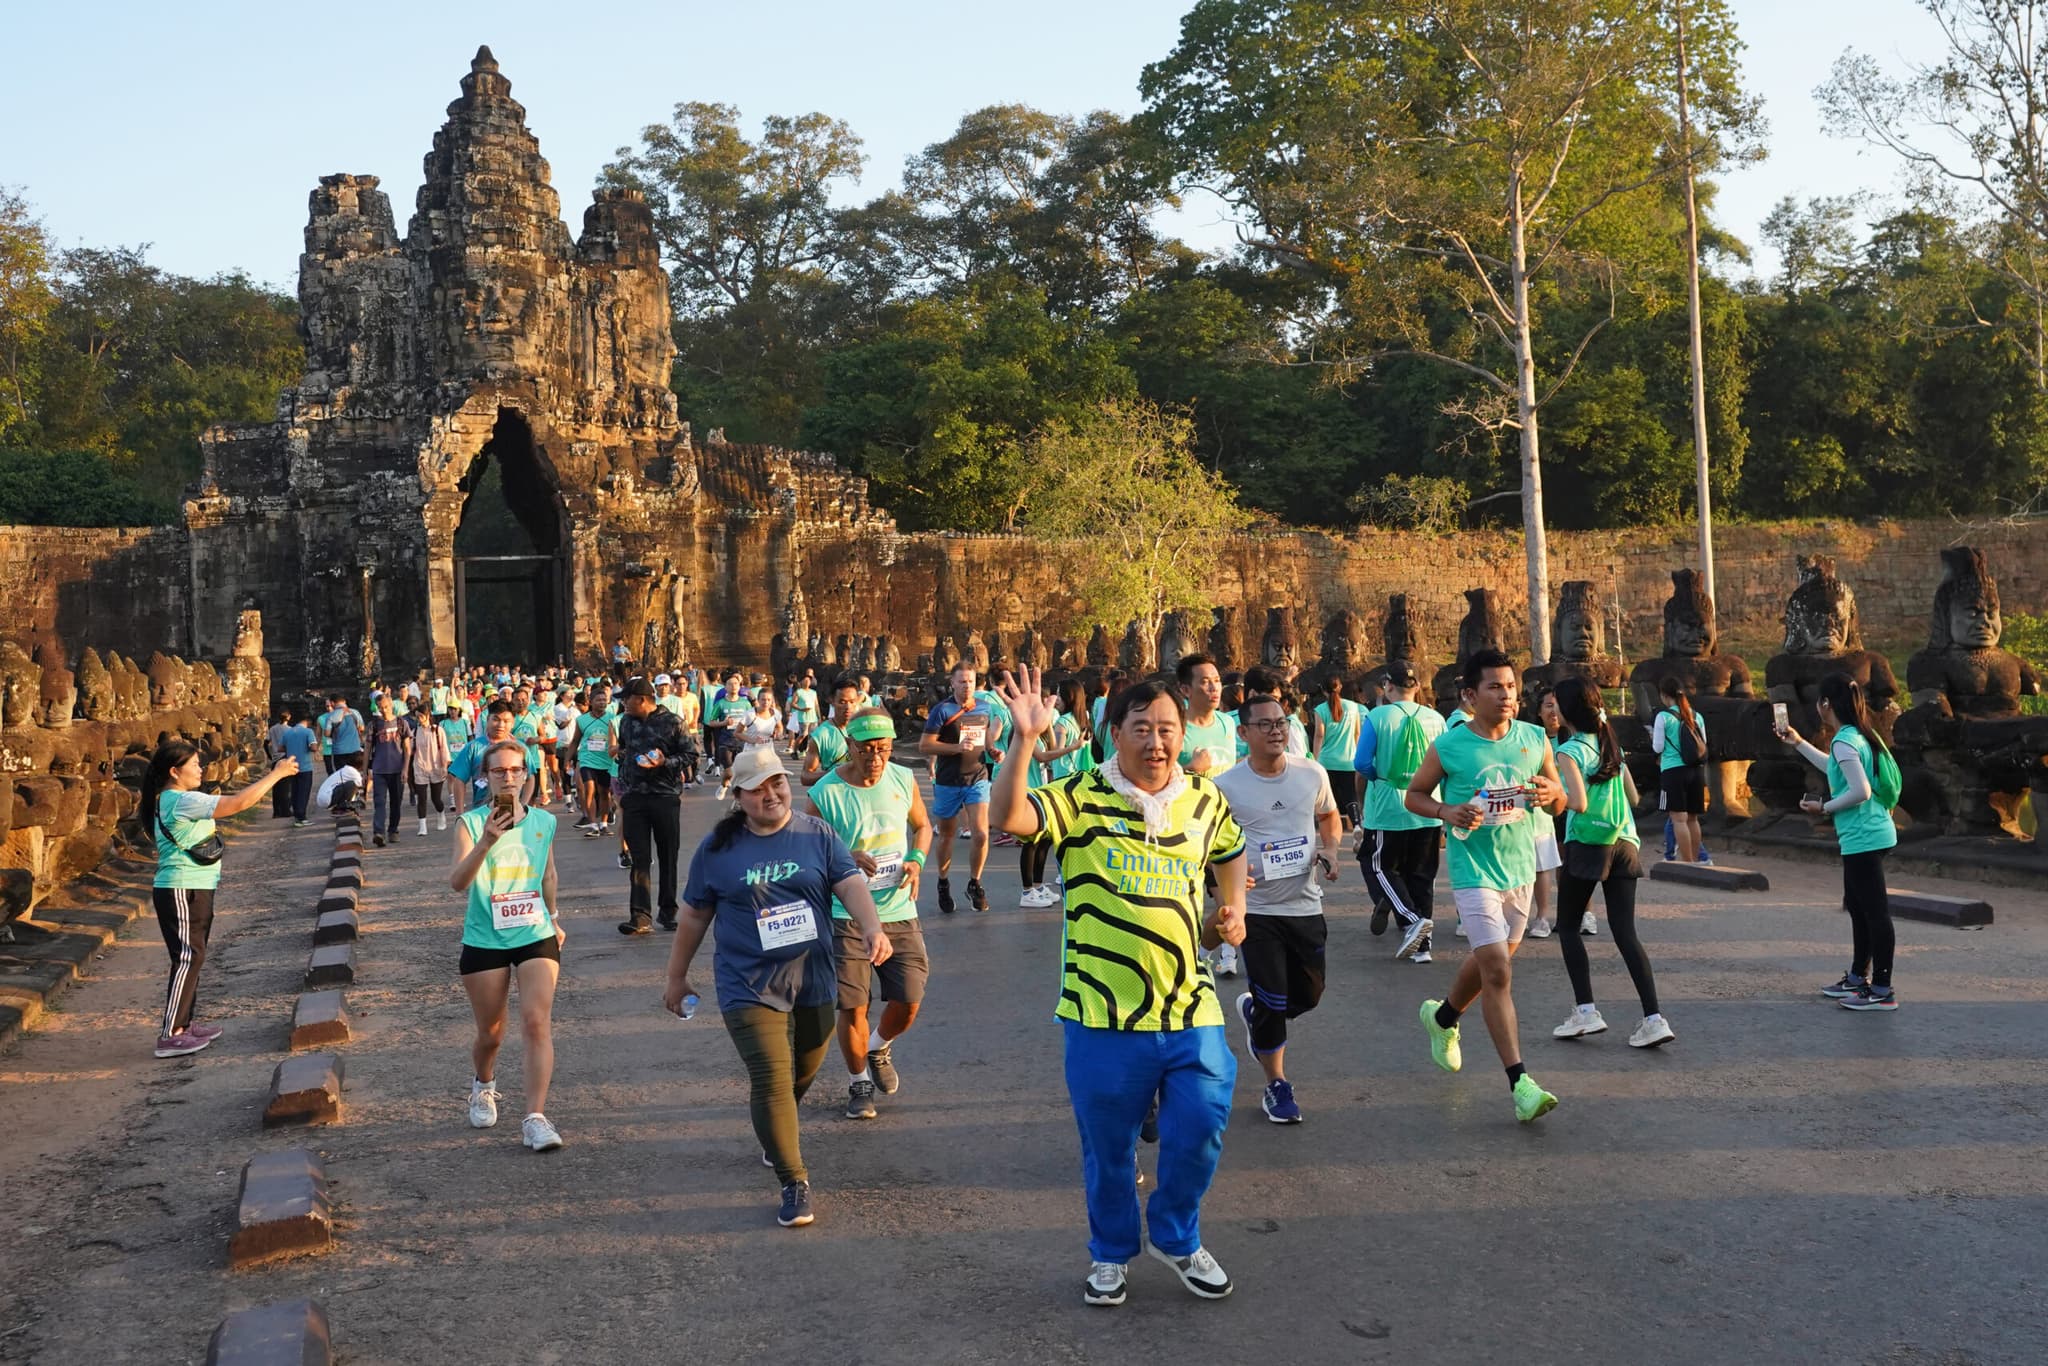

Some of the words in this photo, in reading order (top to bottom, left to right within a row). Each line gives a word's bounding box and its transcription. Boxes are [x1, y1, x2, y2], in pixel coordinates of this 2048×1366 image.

[1487, 798, 1515, 813] 7113
[1106, 847, 1200, 878] Emirates
[1270, 849, 1304, 864] F5-1365
[746, 862, 800, 886] WILD
[1119, 874, 1142, 893] FLY
[1145, 877, 1188, 897] BETTER
[501, 902, 534, 918] 6822
[767, 914, 807, 931] F5-0221
